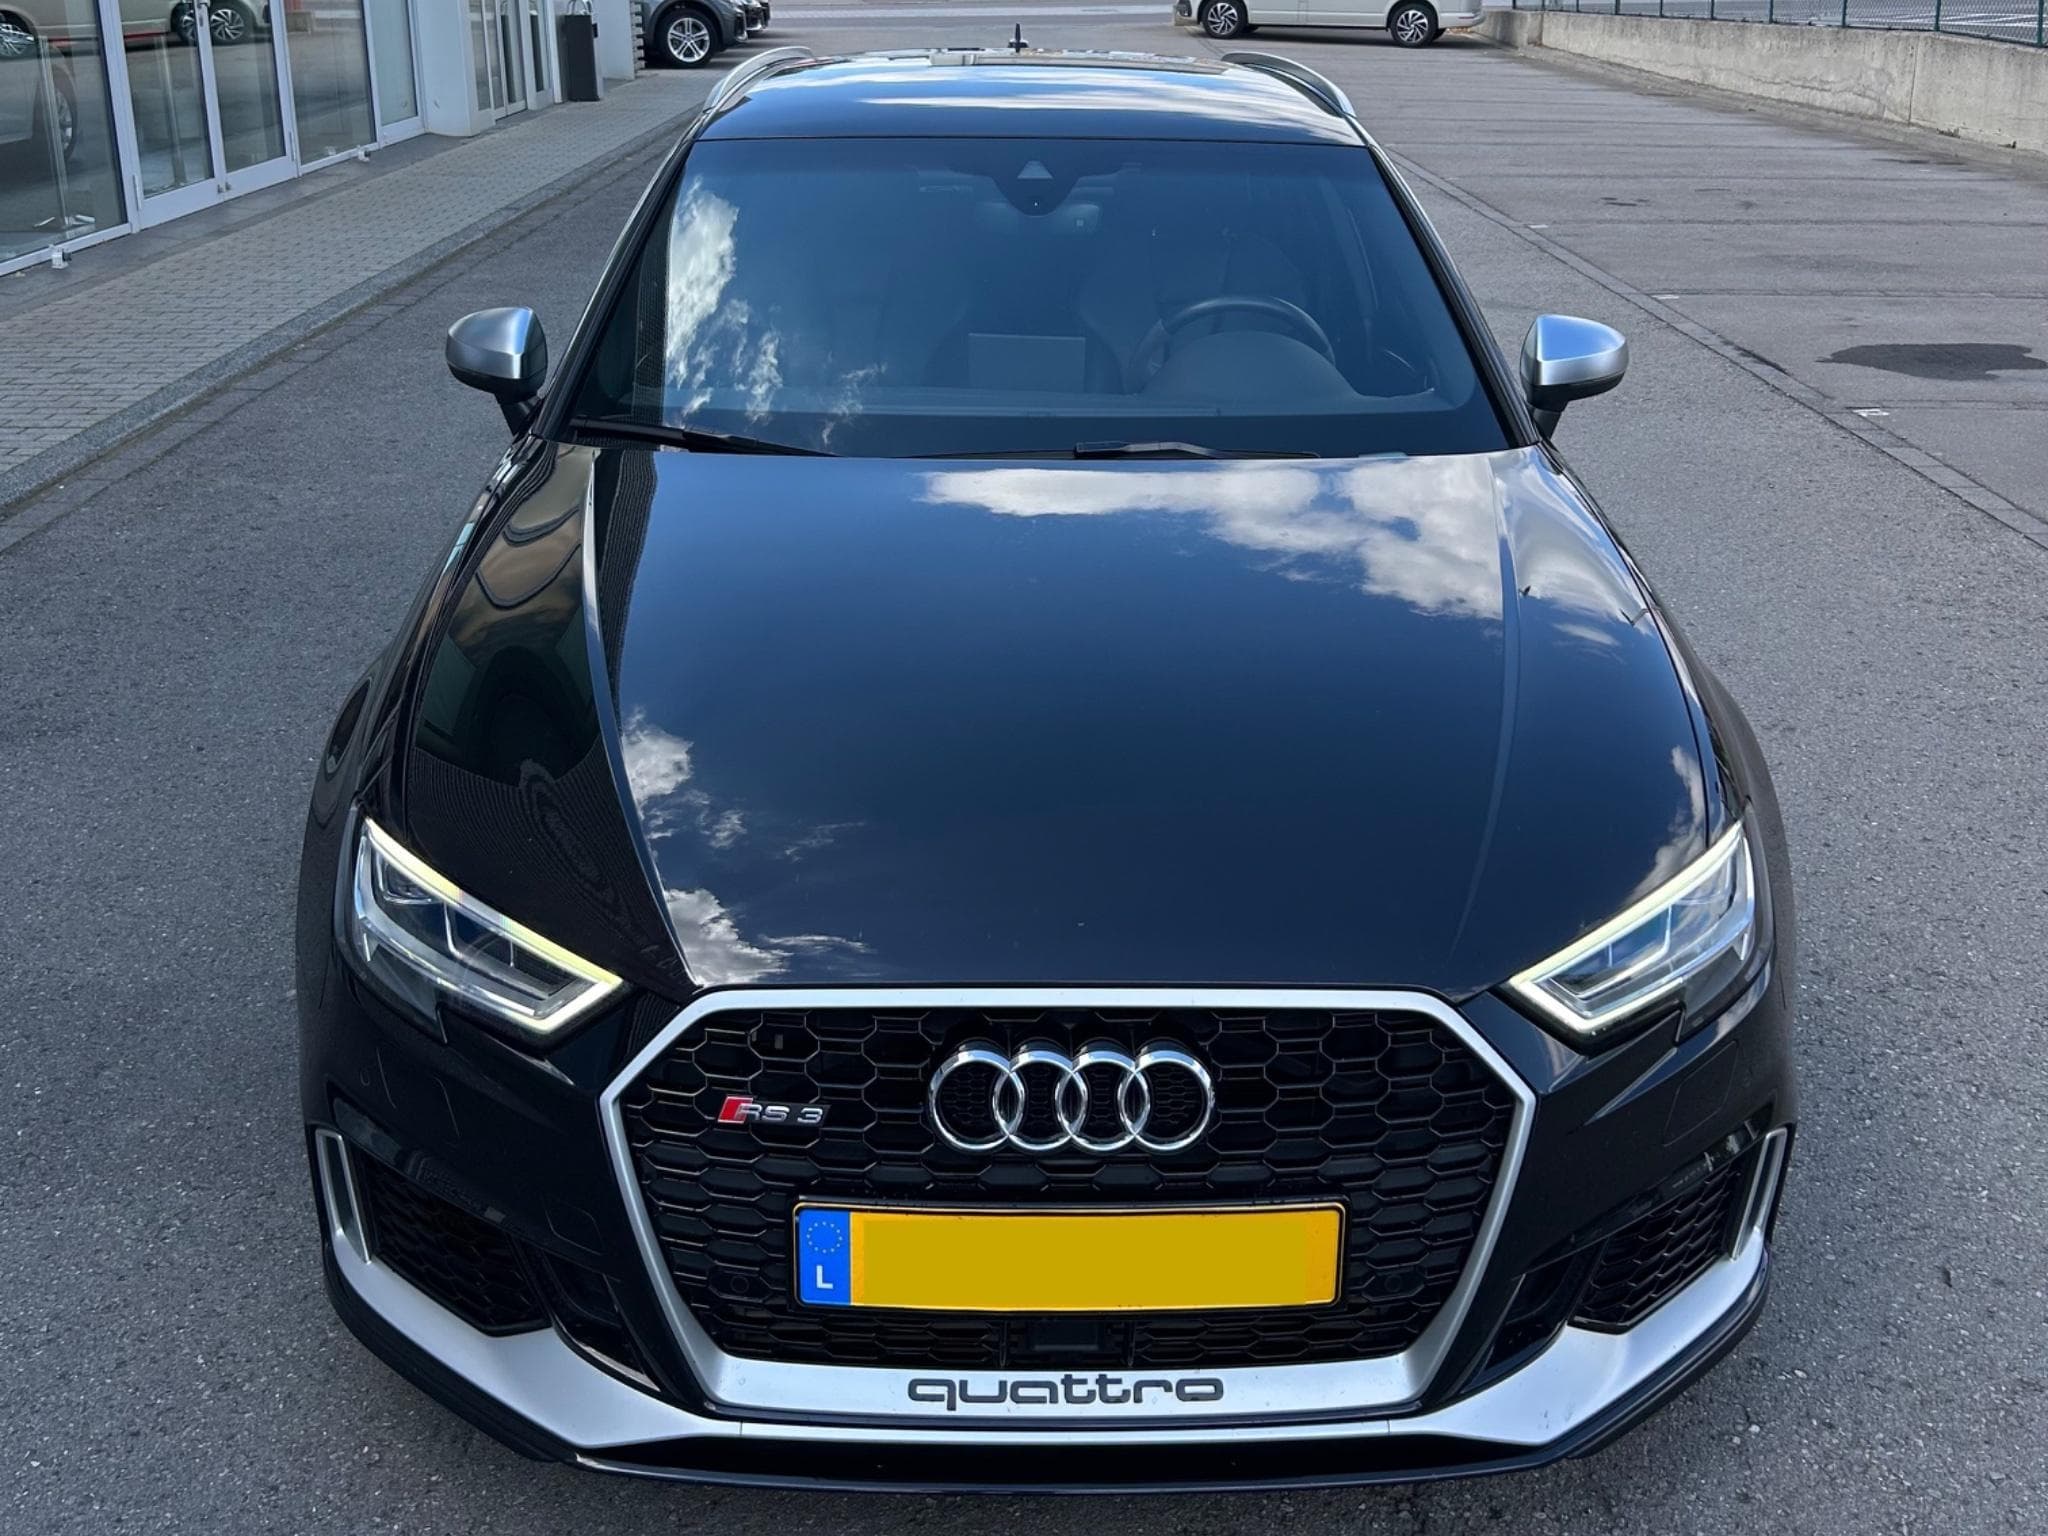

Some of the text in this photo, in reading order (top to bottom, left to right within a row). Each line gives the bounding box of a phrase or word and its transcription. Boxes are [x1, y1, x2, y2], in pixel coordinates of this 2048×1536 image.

[734, 1102, 823, 1123] RS 3
[816, 1264, 834, 1289] L
[907, 1373, 1224, 1412] quattro
